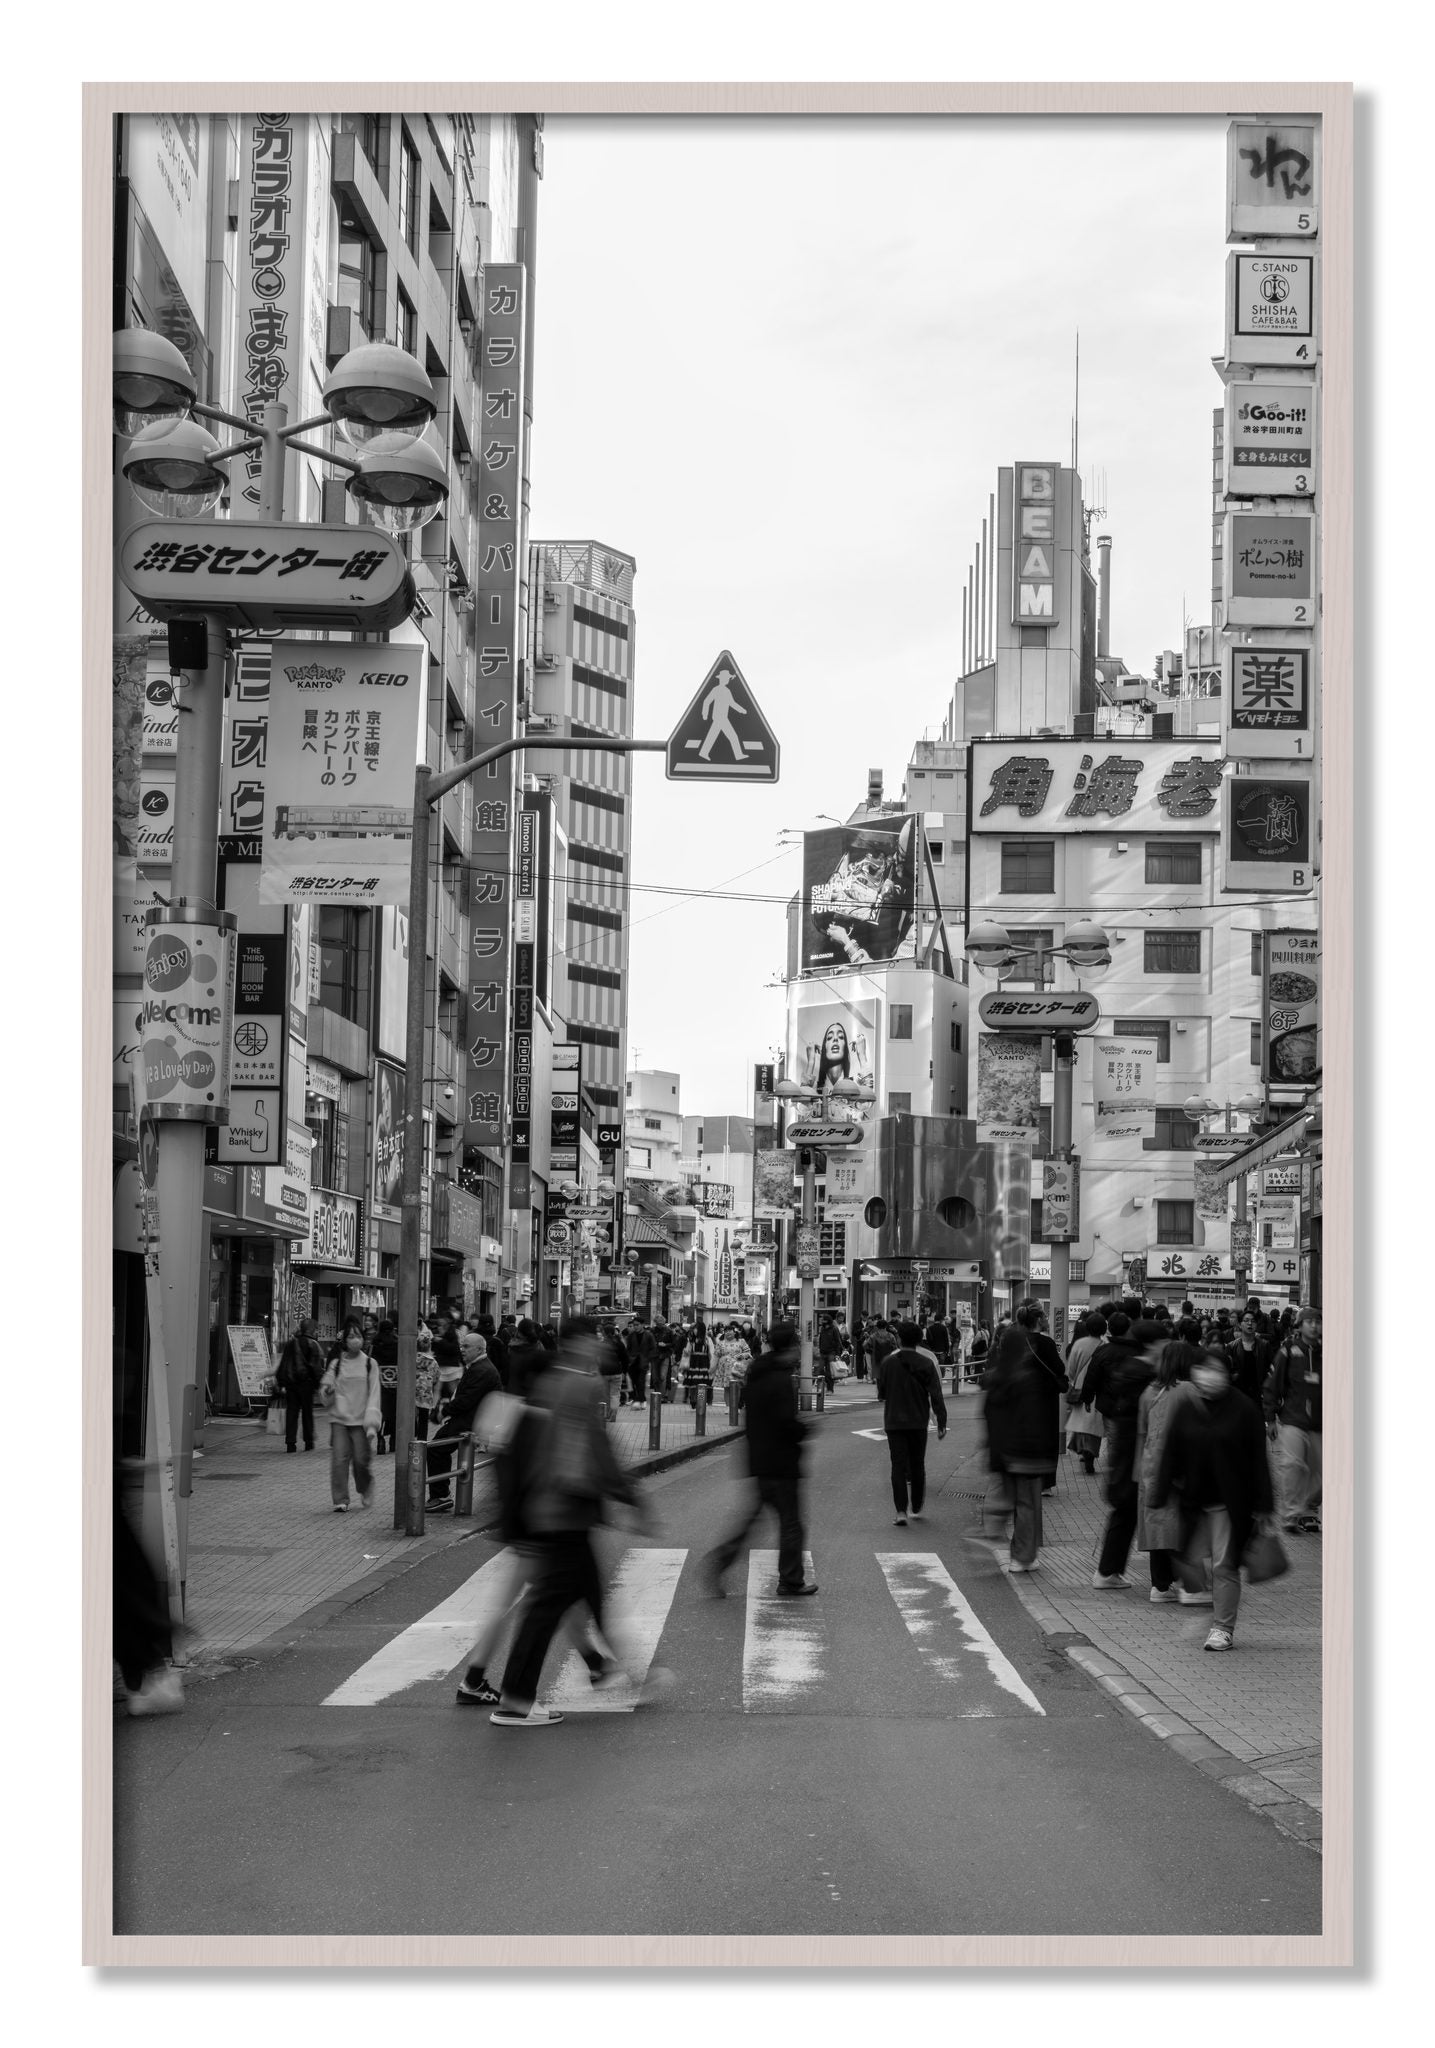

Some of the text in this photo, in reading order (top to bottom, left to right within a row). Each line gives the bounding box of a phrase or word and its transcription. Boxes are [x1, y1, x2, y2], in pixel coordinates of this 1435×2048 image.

[250, 126, 293, 269] カラオケ
[1297, 214, 1310, 230] 5
[1251, 262, 1298, 273] C.STAND
[1251, 304, 1298, 316] SHISHA
[1251, 316, 1298, 325] CAFE&BAR
[1295, 344, 1309, 360] 4
[1250, 405, 1306, 421] Goo-it!
[1243, 425, 1303, 435] 渋谷宇田川町店
[1238, 451, 1308, 464] 全身もみほぐし
[1294, 474, 1308, 492] 3
[1020, 467, 1054, 617] BEAM
[133, 541, 390, 581] 渋谷センター街
[1249, 572, 1296, 580] Pomme-no-ki
[1294, 605, 1307, 622] 2
[297, 681, 333, 689] KANTO
[358, 672, 409, 687] KEIO
[1242, 655, 1294, 708] 薬
[1236, 711, 1300, 726] マツモトキヨシ
[302, 709, 318, 753] 冒険へ
[147, 737, 173, 747] 渋谷店
[320, 709, 339, 786] カントーの
[341, 709, 360, 786] ポケパーク
[363, 710, 381, 772] 京王線で
[1293, 737, 1303, 754] 1
[979, 754, 1228, 818] 角海老
[1236, 794, 1299, 845] 一蘭
[142, 848, 168, 857] 渋谷店
[521, 816, 532, 893] kimono hearts
[288, 876, 380, 891] 渋谷センター街
[1292, 869, 1305, 886] B
[242, 954, 265, 962] THIRD
[246, 947, 261, 955] THE
[146, 948, 188, 985] Enjoy
[241, 983, 264, 991] ROOM
[244, 994, 260, 1002] BAR
[468, 872, 505, 1124] カラオケ館
[142, 999, 222, 1026] Welcome
[986, 1001, 1092, 1015] 渋谷センター街
[1269, 1010, 1300, 1031] 6F
[1131, 1048, 1153, 1056] KEIO
[160, 1059, 192, 1080] Lovely
[193, 1060, 214, 1075] Day!
[229, 1127, 264, 1139] Whisky
[599, 1130, 621, 1142] GU
[790, 1127, 854, 1137] 渋谷センター街
[228, 1137, 250, 1146] Bank
[1196, 1138, 1256, 1147] 渋谷センター街
[1160, 1253, 1223, 1276] 兆楽
[721, 1251, 731, 1296] BEER
[718, 1297, 732, 1305] HALL
